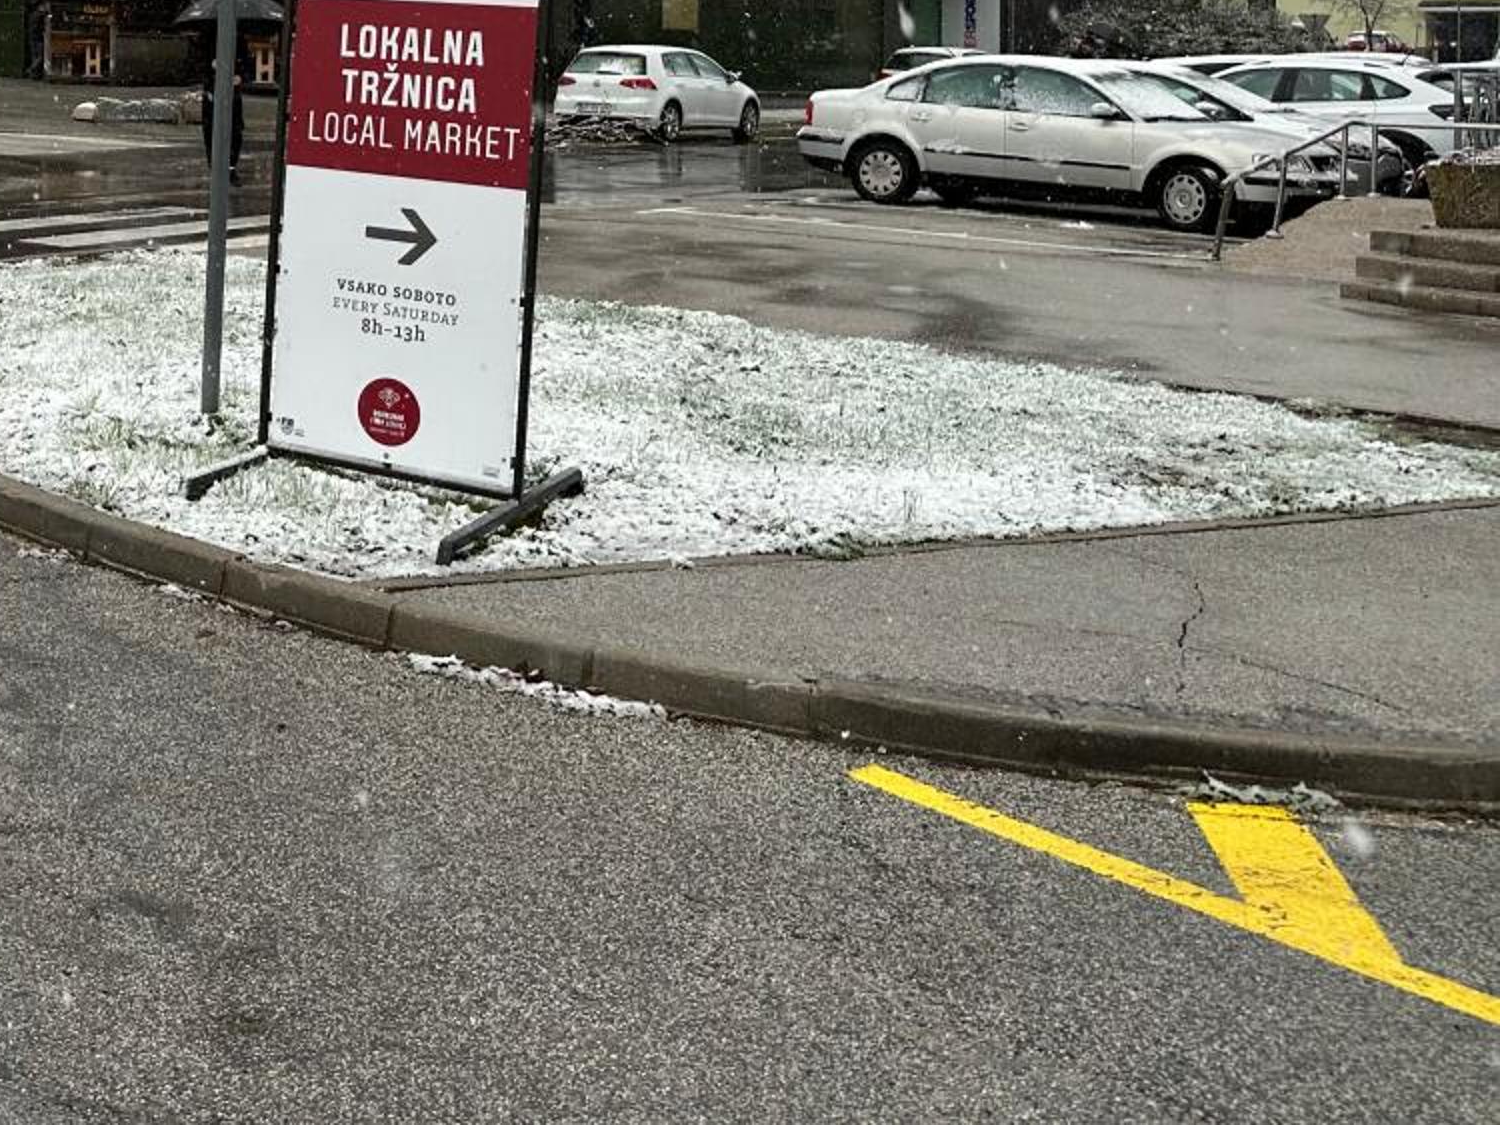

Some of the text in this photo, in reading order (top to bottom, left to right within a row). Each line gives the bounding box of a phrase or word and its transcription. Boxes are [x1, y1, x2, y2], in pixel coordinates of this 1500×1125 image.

[340, 23, 484, 66] LOKALNA
[341, 62, 476, 114] TRŽNICA
[307, 110, 521, 161] LOCAL MARKET
[333, 296, 379, 314] EVERY
[337, 278, 457, 306] VSAKO SOBOTO
